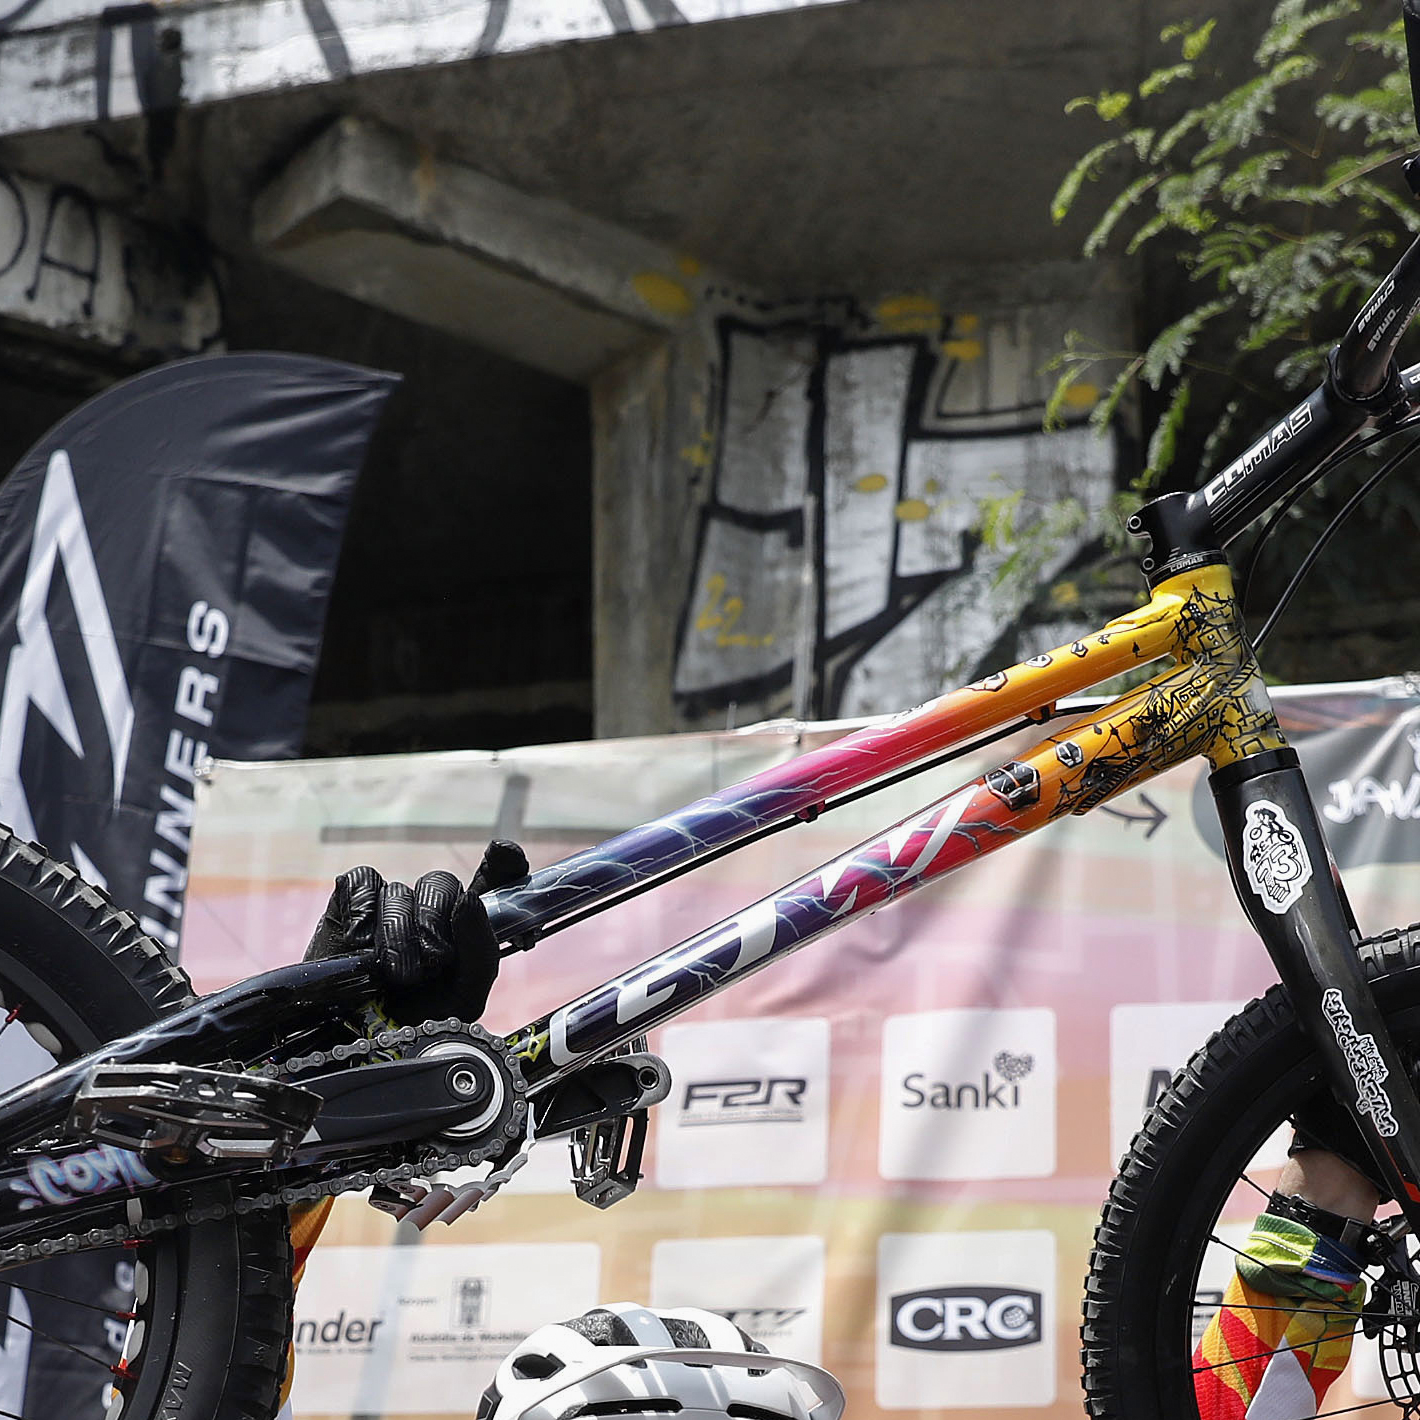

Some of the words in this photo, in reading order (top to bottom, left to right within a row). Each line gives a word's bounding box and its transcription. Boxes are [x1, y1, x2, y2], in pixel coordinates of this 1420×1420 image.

[1203, 402, 1313, 507] COMAS
[138, 599, 232, 952] INNERS
[902, 1070, 1021, 1111] Sanki
[296, 1310, 386, 1345] nder
[895, 1295, 1038, 1342] CRC
